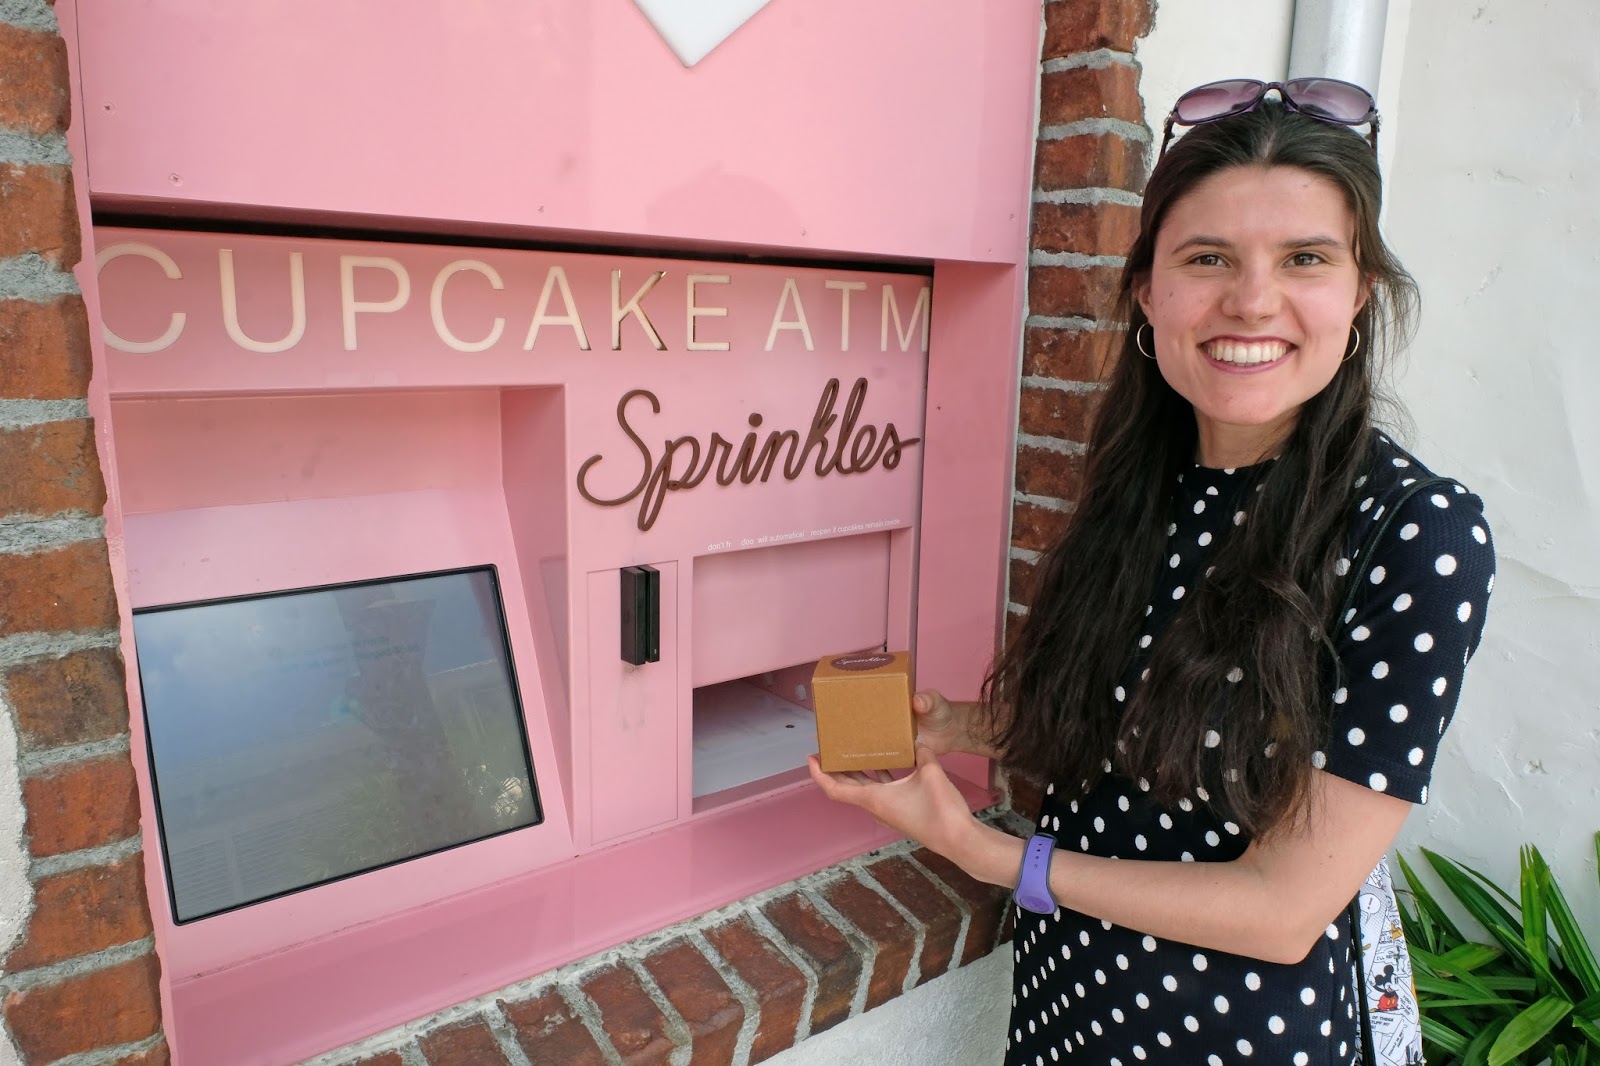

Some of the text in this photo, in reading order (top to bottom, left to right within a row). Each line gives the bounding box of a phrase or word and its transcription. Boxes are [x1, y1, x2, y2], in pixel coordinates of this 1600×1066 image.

[95, 241, 931, 354] CUPCAKE ATM
[577, 378, 921, 532] Sprinkles
[837, 522, 864, 533] cupcakes
